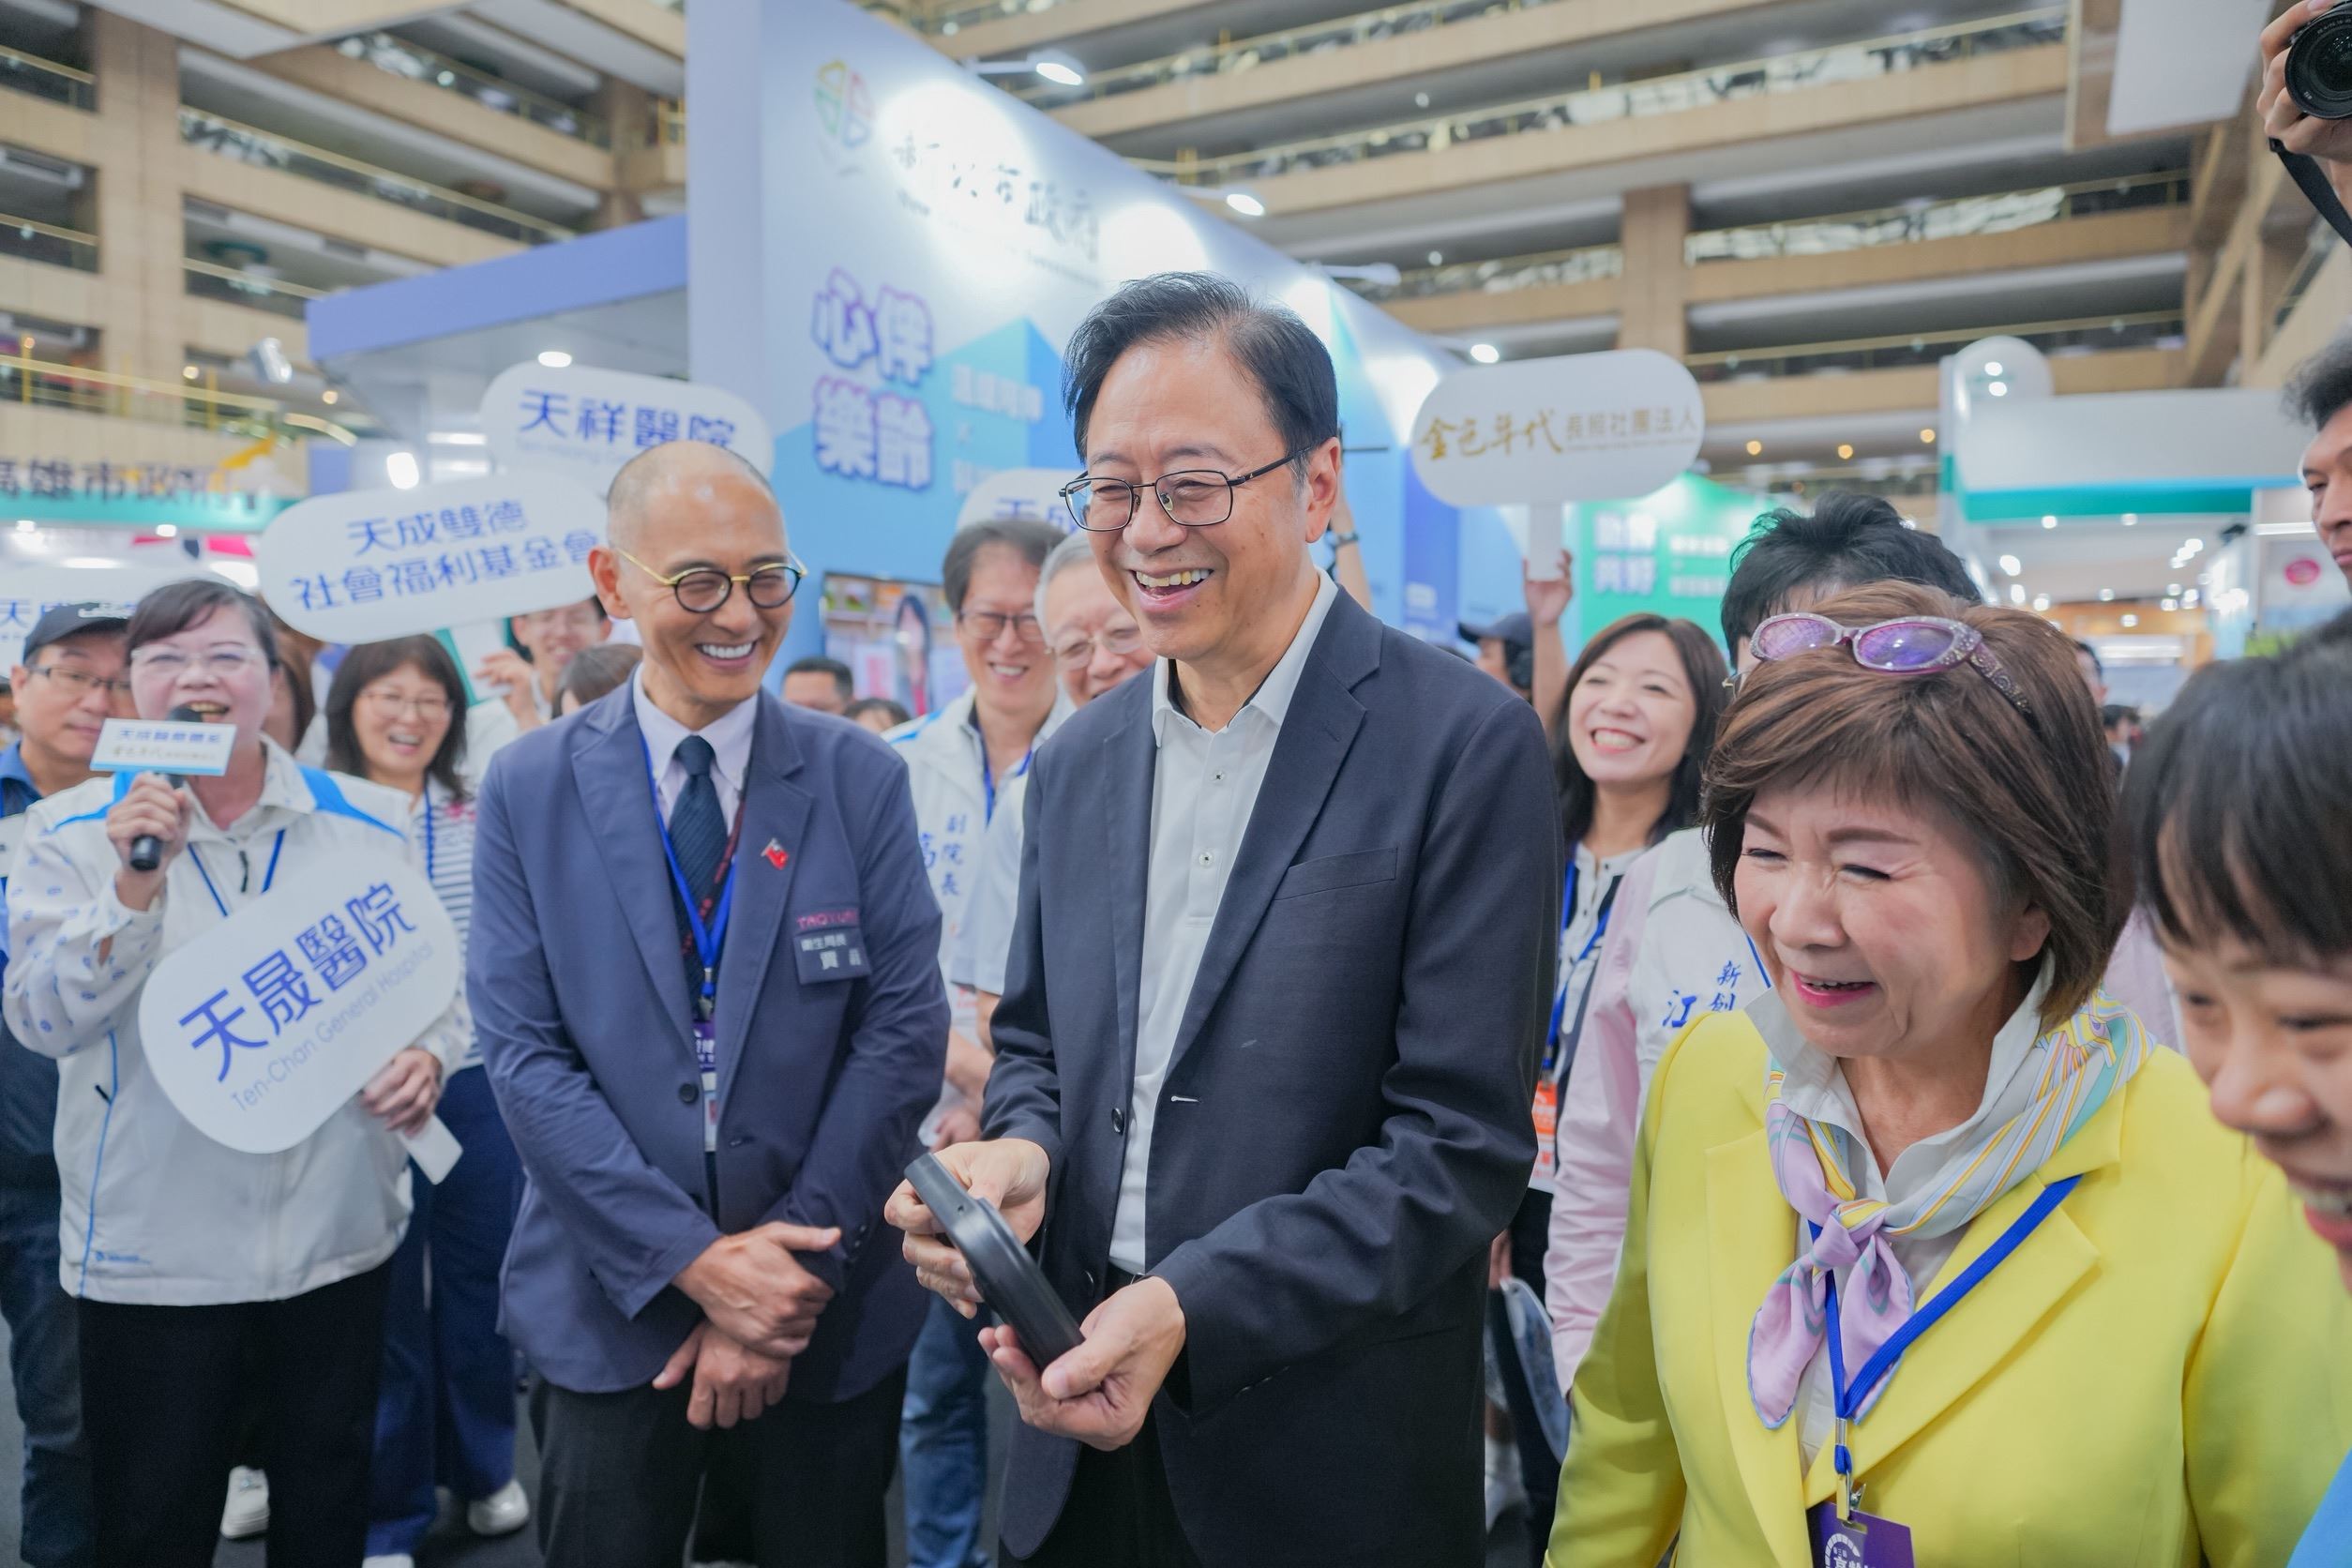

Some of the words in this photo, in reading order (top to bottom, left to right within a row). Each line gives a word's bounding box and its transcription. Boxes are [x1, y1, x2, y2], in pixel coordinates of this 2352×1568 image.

[893, 133, 1099, 264] 新市政府
[519, 387, 736, 449] 天祥醫院
[291, 529, 599, 611] 社會福利基金會
[347, 500, 529, 556] 天成雙德
[177, 882, 417, 1083] 天晟醫院
[230, 1037, 317, 1111] Ten-Chan
[314, 989, 381, 1045] General
